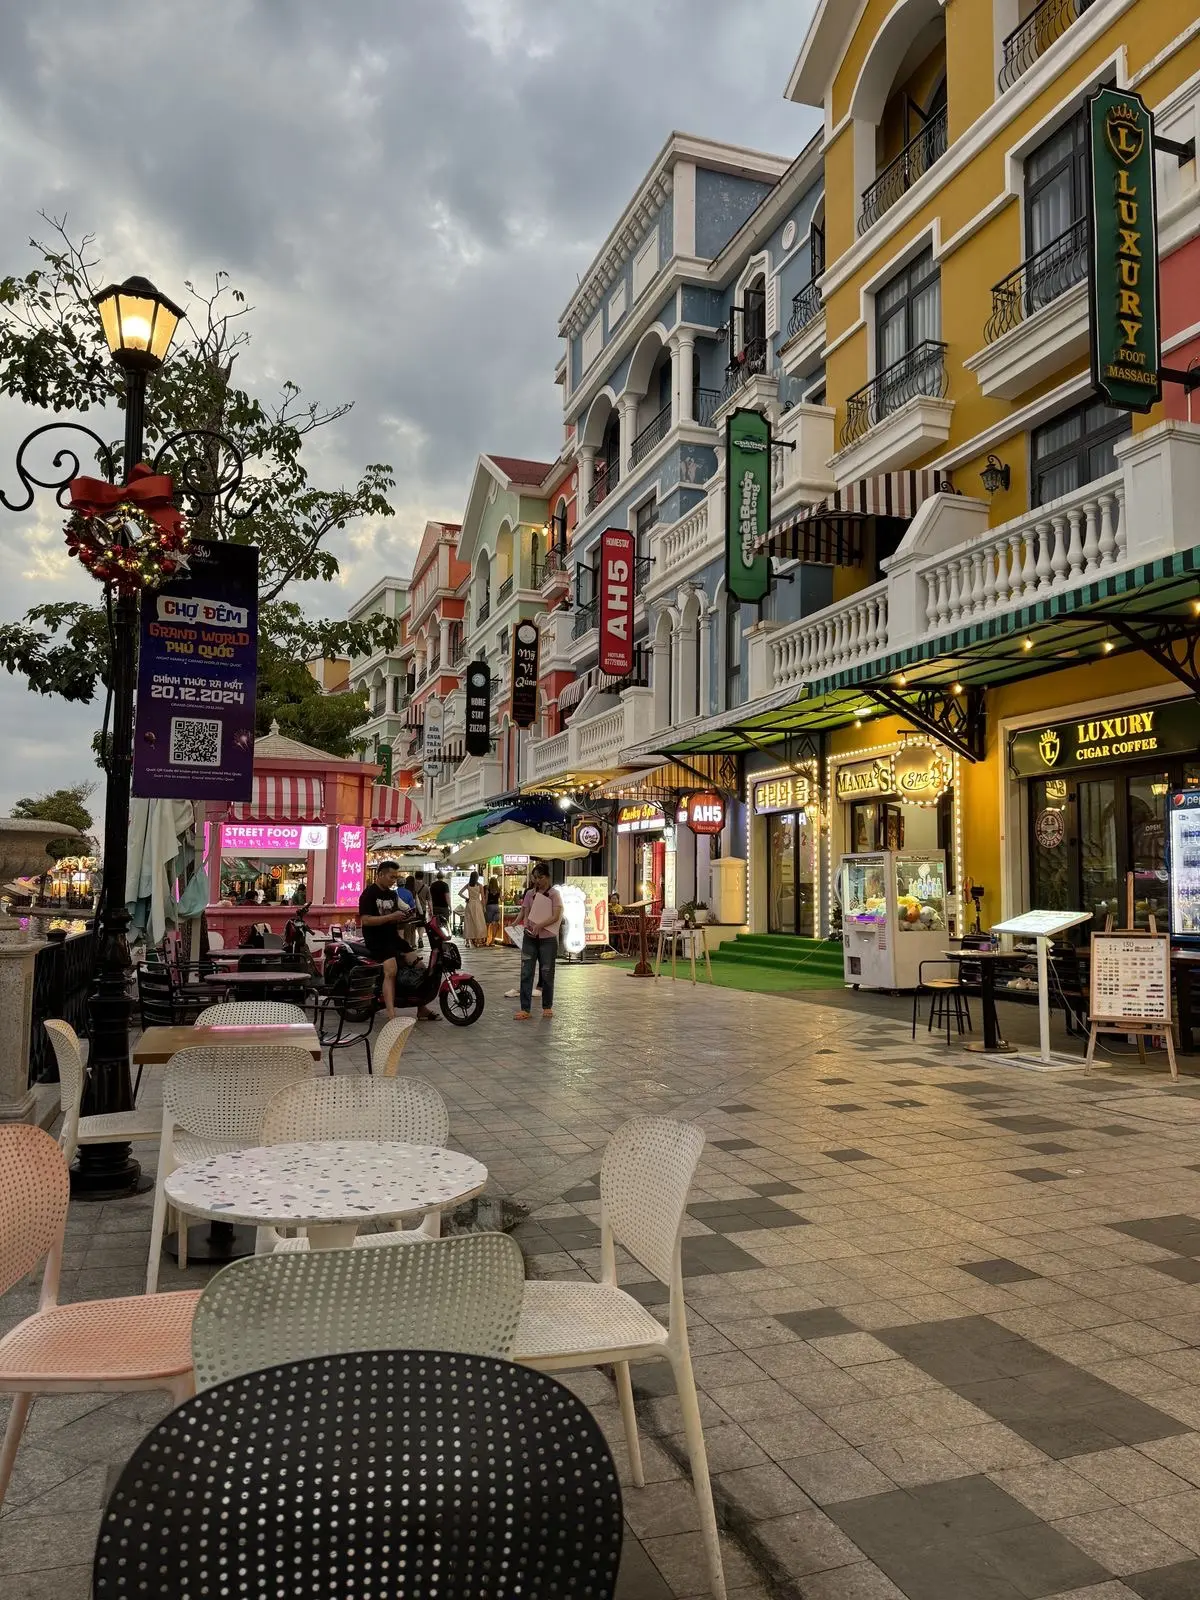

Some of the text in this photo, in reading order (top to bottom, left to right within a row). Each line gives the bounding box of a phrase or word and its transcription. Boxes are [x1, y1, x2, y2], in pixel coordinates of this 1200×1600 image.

[1118, 169, 1143, 346] LUXURY
[1119, 349, 1147, 365] FOOT
[1108, 366, 1158, 386] MASSAGE
[607, 559, 629, 641] AH5
[164, 601, 242, 623] CHỢ ĐÊM
[149, 622, 250, 646] GRAND WORLD
[165, 640, 194, 654] PHÚ
[153, 674, 180, 685] CHÍNH
[183, 677, 207, 687] THỨC
[209, 679, 222, 689] RA
[150, 684, 245, 705] 20.12.2024
[470, 697, 487, 707] HOME
[471, 710, 484, 720] STAY
[1077, 711, 1155, 744] LUXURY
[1075, 737, 1158, 761] CIGAR COFFEE
[692, 805, 722, 822] AH5
[225, 827, 298, 838] STREET FOOD
[1145, 823, 1161, 832] OPEN
